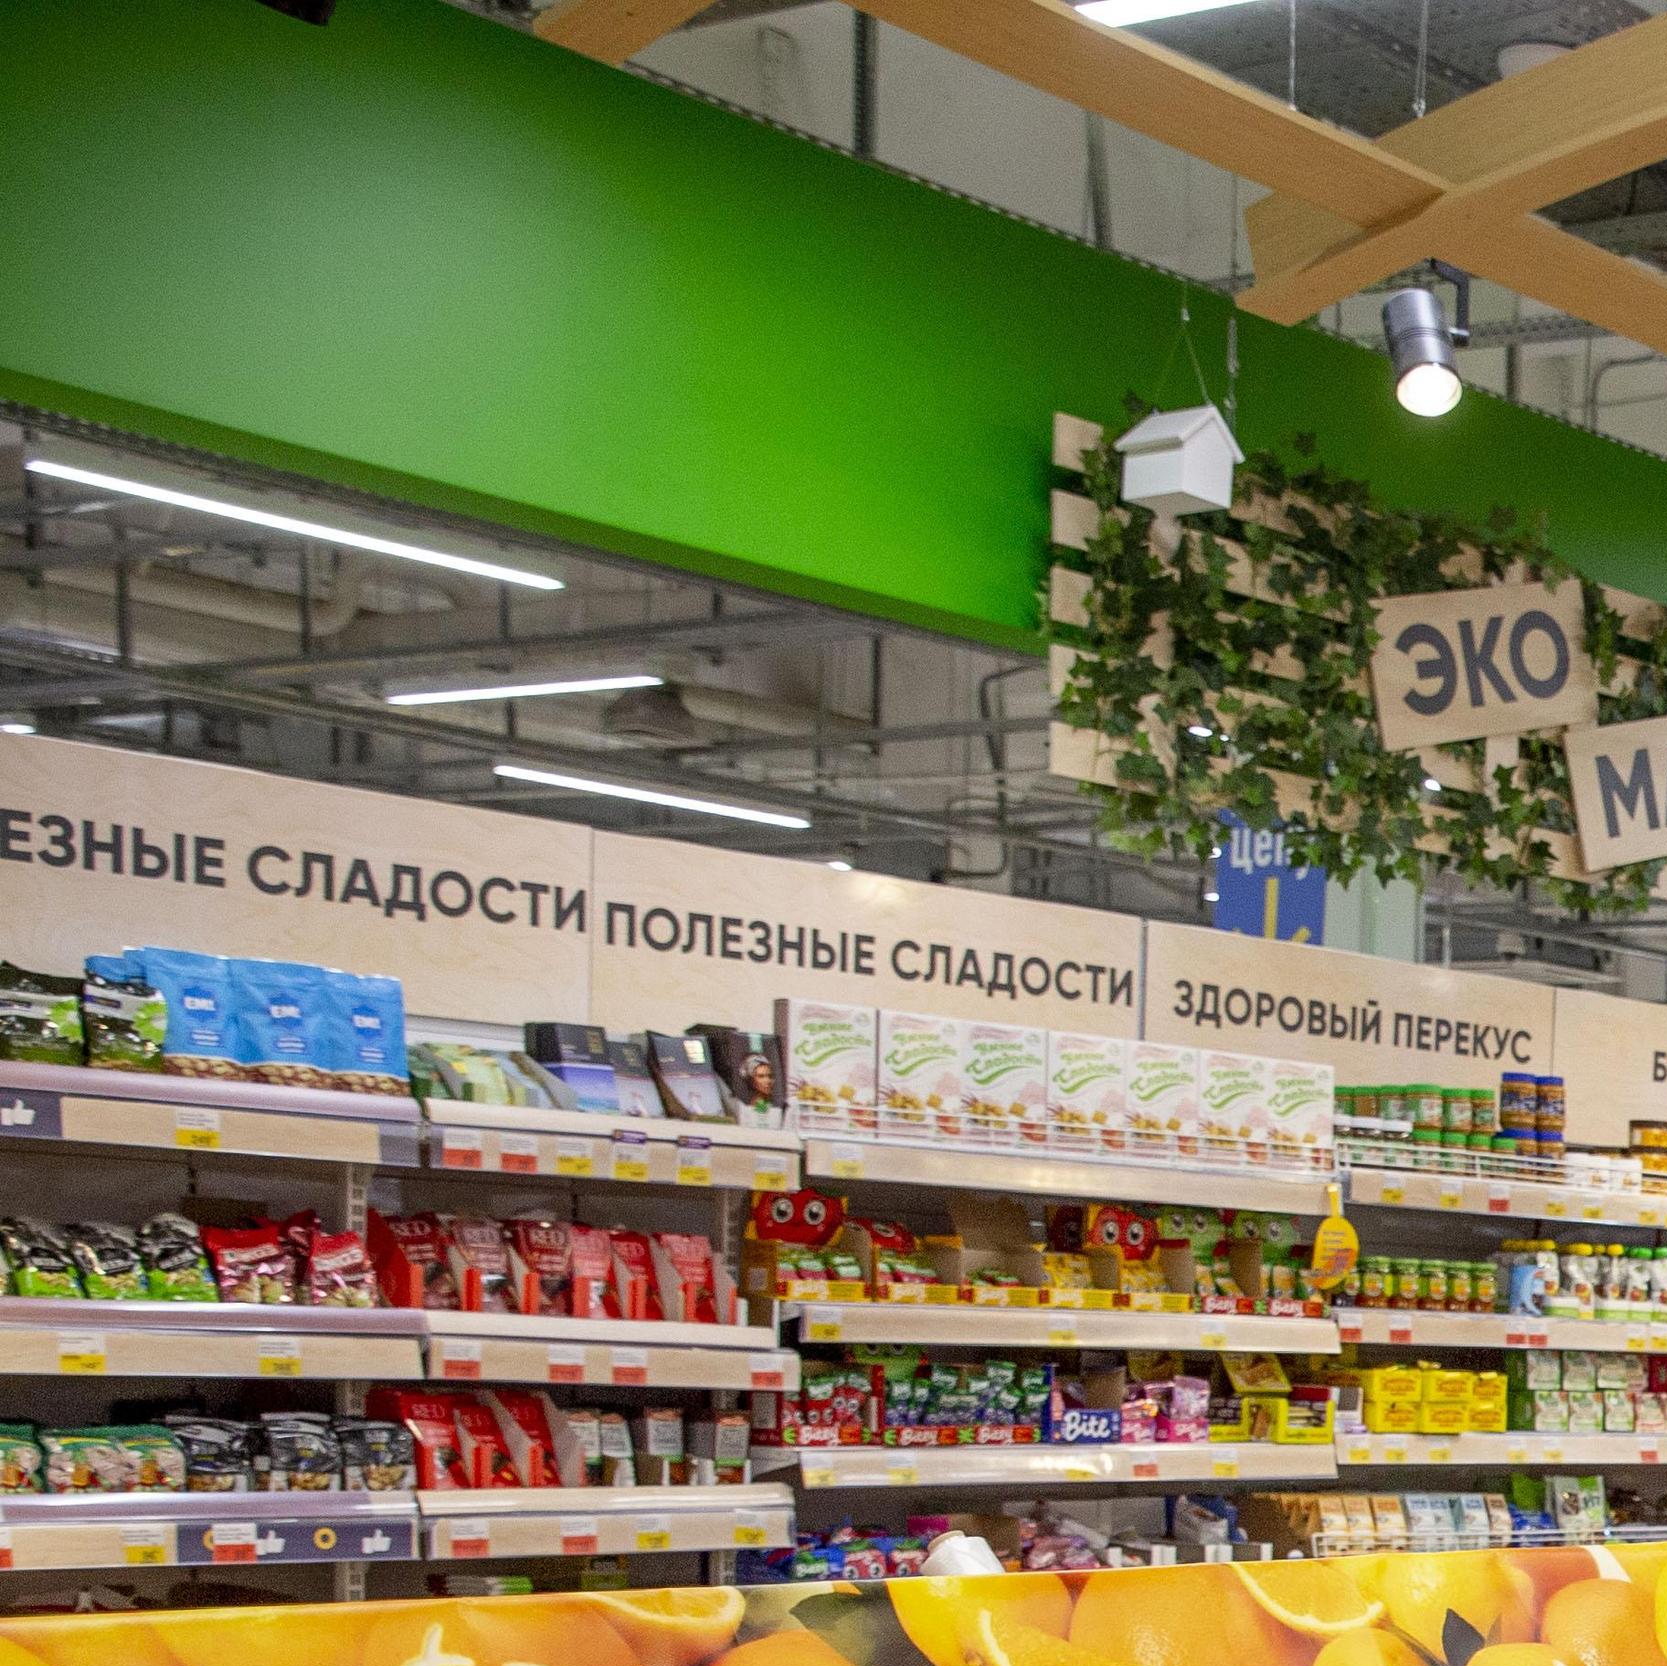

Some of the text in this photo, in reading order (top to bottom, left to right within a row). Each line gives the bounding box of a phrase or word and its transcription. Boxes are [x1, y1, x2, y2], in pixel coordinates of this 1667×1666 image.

[1396, 609, 1571, 717] ЭКО
[0, 808, 588, 933] ЕЗНЫЕ СЛАДОСТИ
[606, 901, 1135, 1008] ПОЛЕЗНЫЕ СЛАДОСТИ
[1173, 979, 1534, 1064] ЗДОРОВЫЙ ПЕРЕКУС
[1061, 1411, 1112, 1443] Bite
